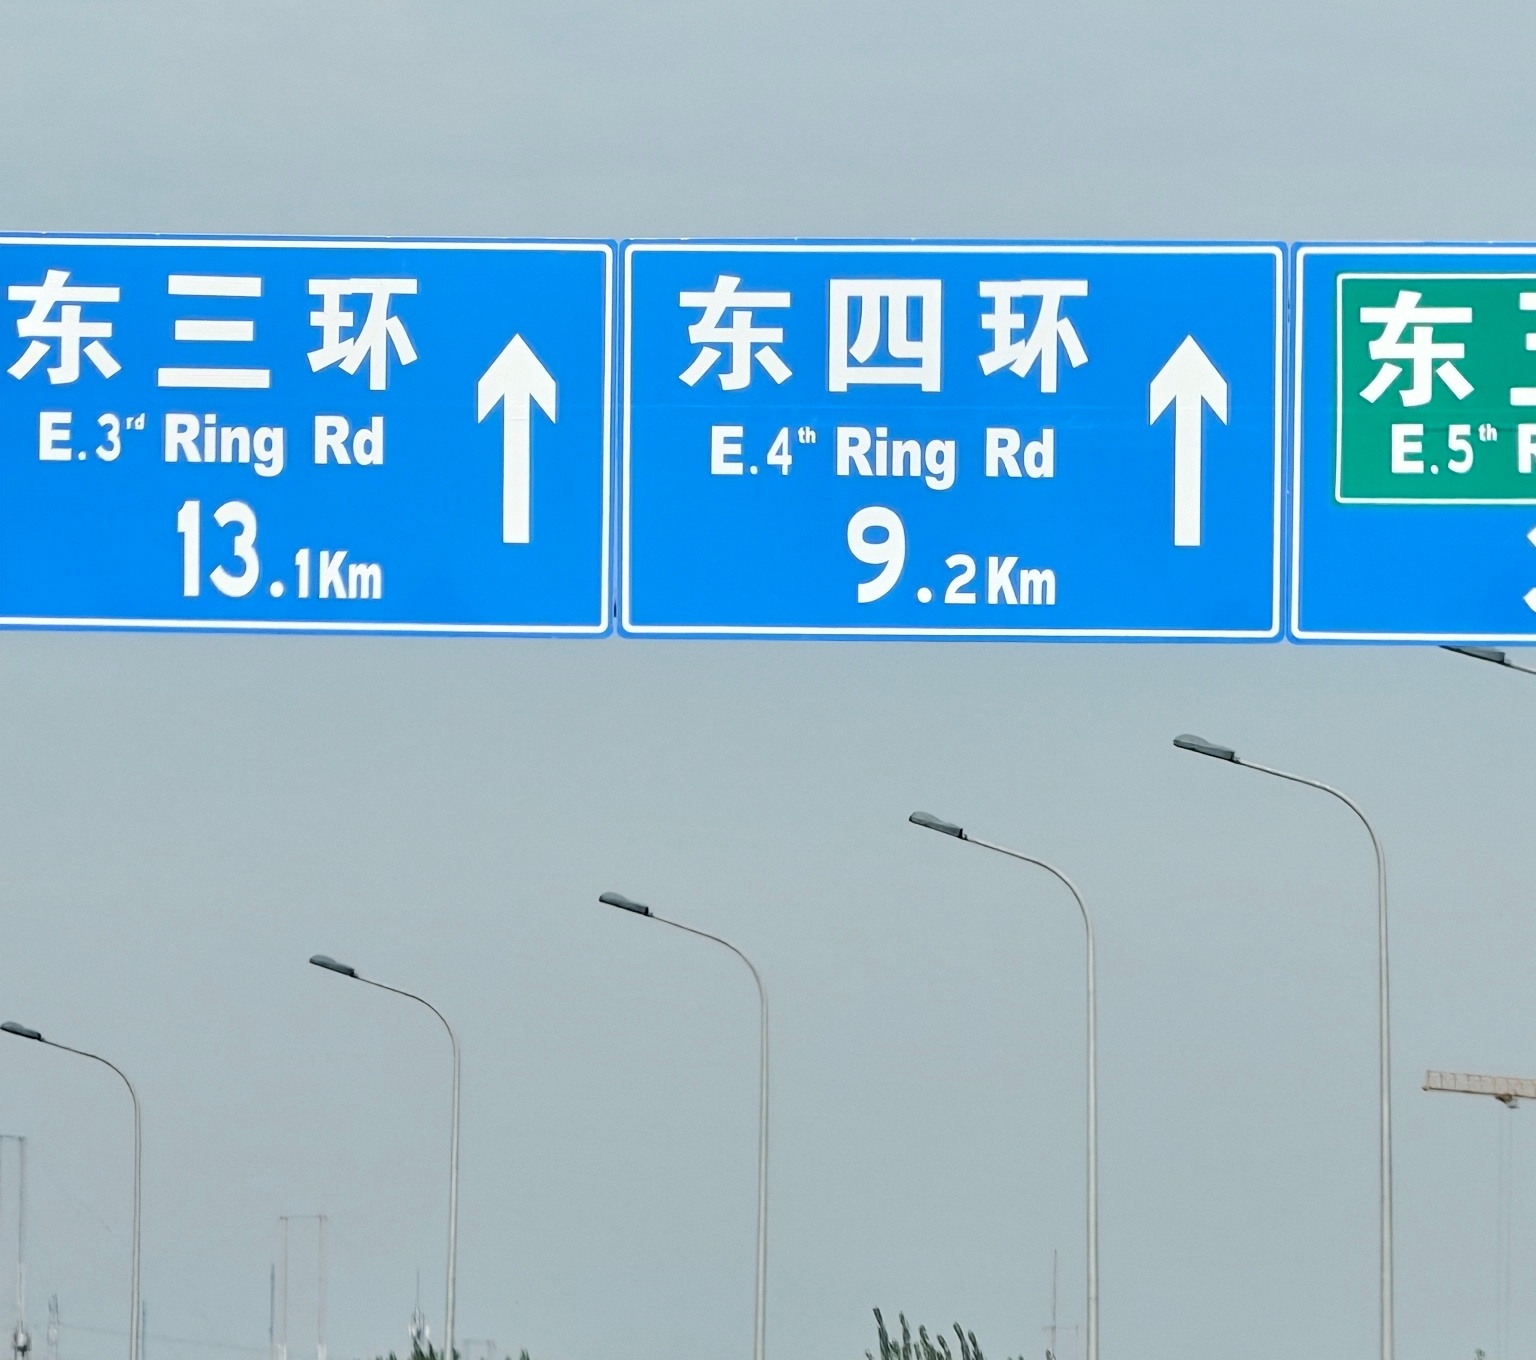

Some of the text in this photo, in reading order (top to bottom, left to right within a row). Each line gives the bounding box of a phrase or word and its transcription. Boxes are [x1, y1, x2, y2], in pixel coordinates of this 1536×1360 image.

[8, 269, 417, 390] 东三环
[679, 275, 1088, 392] 东四环
[165, 413, 283, 477] Ring
[315, 416, 383, 465] Rd
[837, 427, 955, 490] Ring
[986, 428, 1054, 478] Rd
[178, 501, 381, 599] 13.1Km
[848, 506, 1055, 604] 9.2Km
